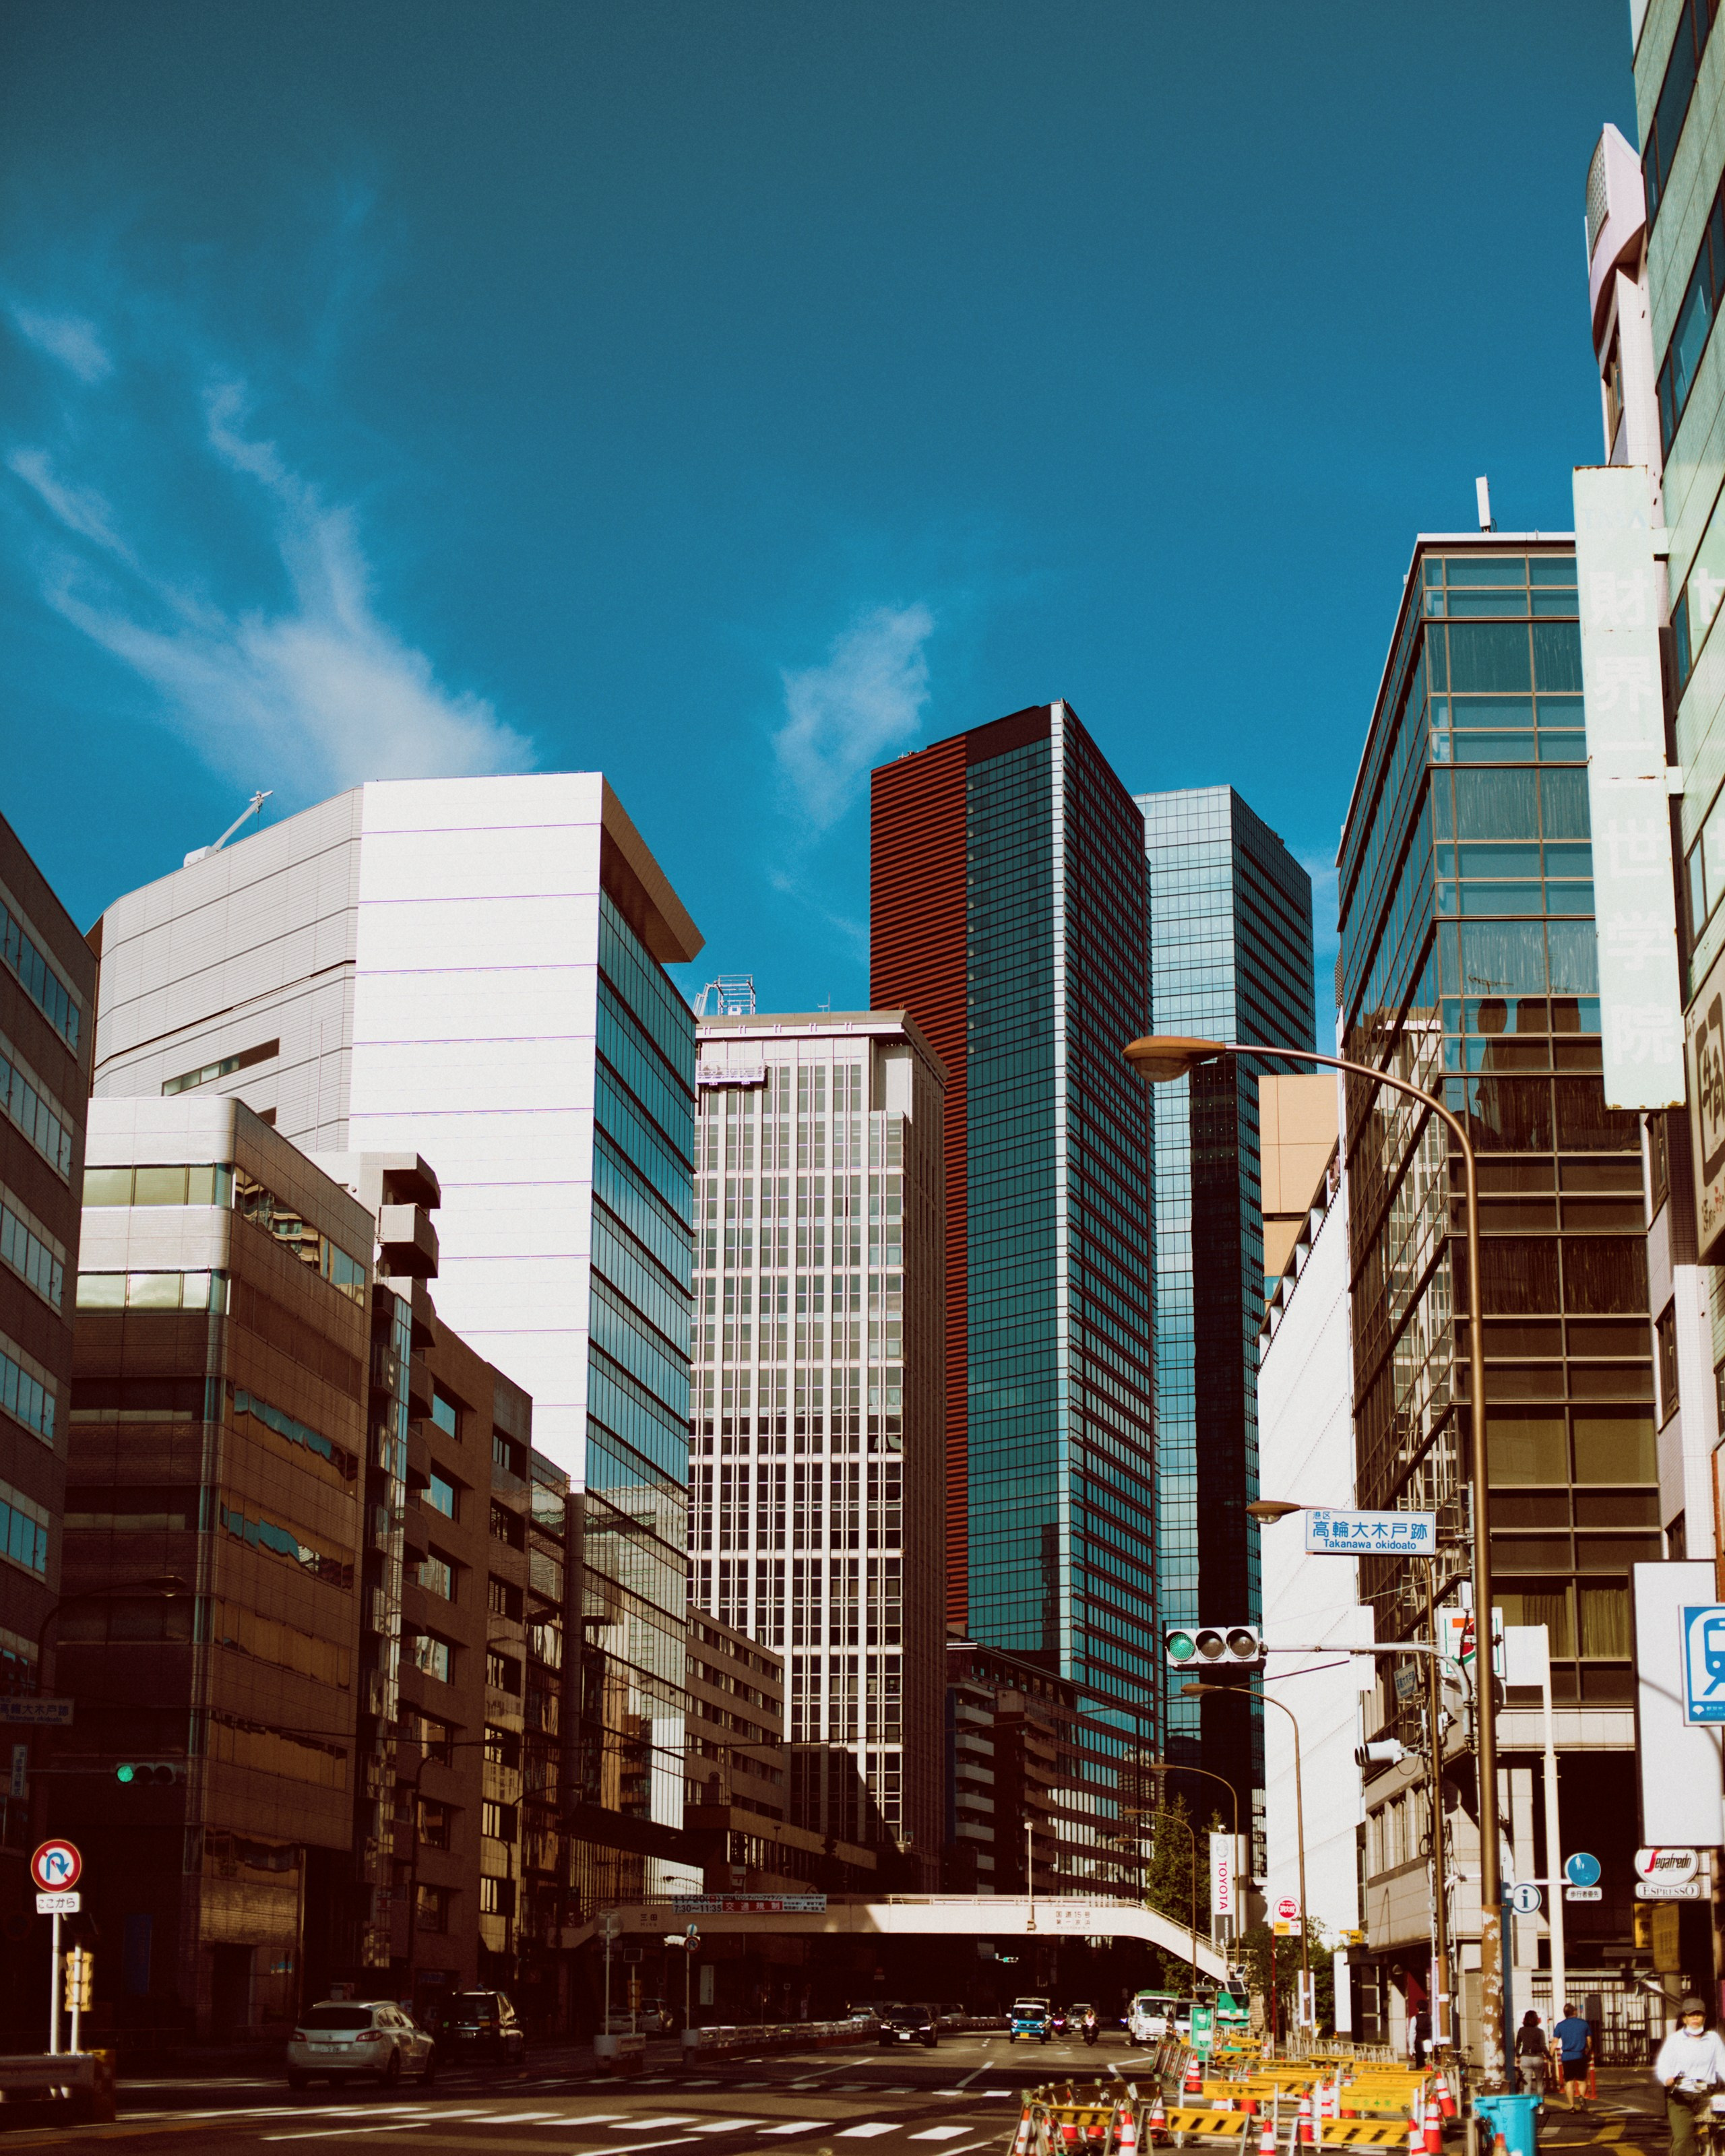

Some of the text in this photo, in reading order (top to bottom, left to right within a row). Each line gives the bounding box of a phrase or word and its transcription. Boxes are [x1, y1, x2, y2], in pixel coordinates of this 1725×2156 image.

[1589, 569, 1674, 1065] 財界二世学院
[1313, 1511, 1331, 1520] 港区
[1313, 1521, 1428, 1540] 高輪大木戸跡
[1323, 1538, 1416, 1550] Takanawa okidoato
[1644, 1848, 1692, 1873] Segafredo
[1218, 1861, 1228, 1909] TOYOTA
[1643, 1886, 1695, 1896] ESPRESSO
[38, 1897, 75, 1909] ここから
[726, 1901, 780, 1911] 交通規制
